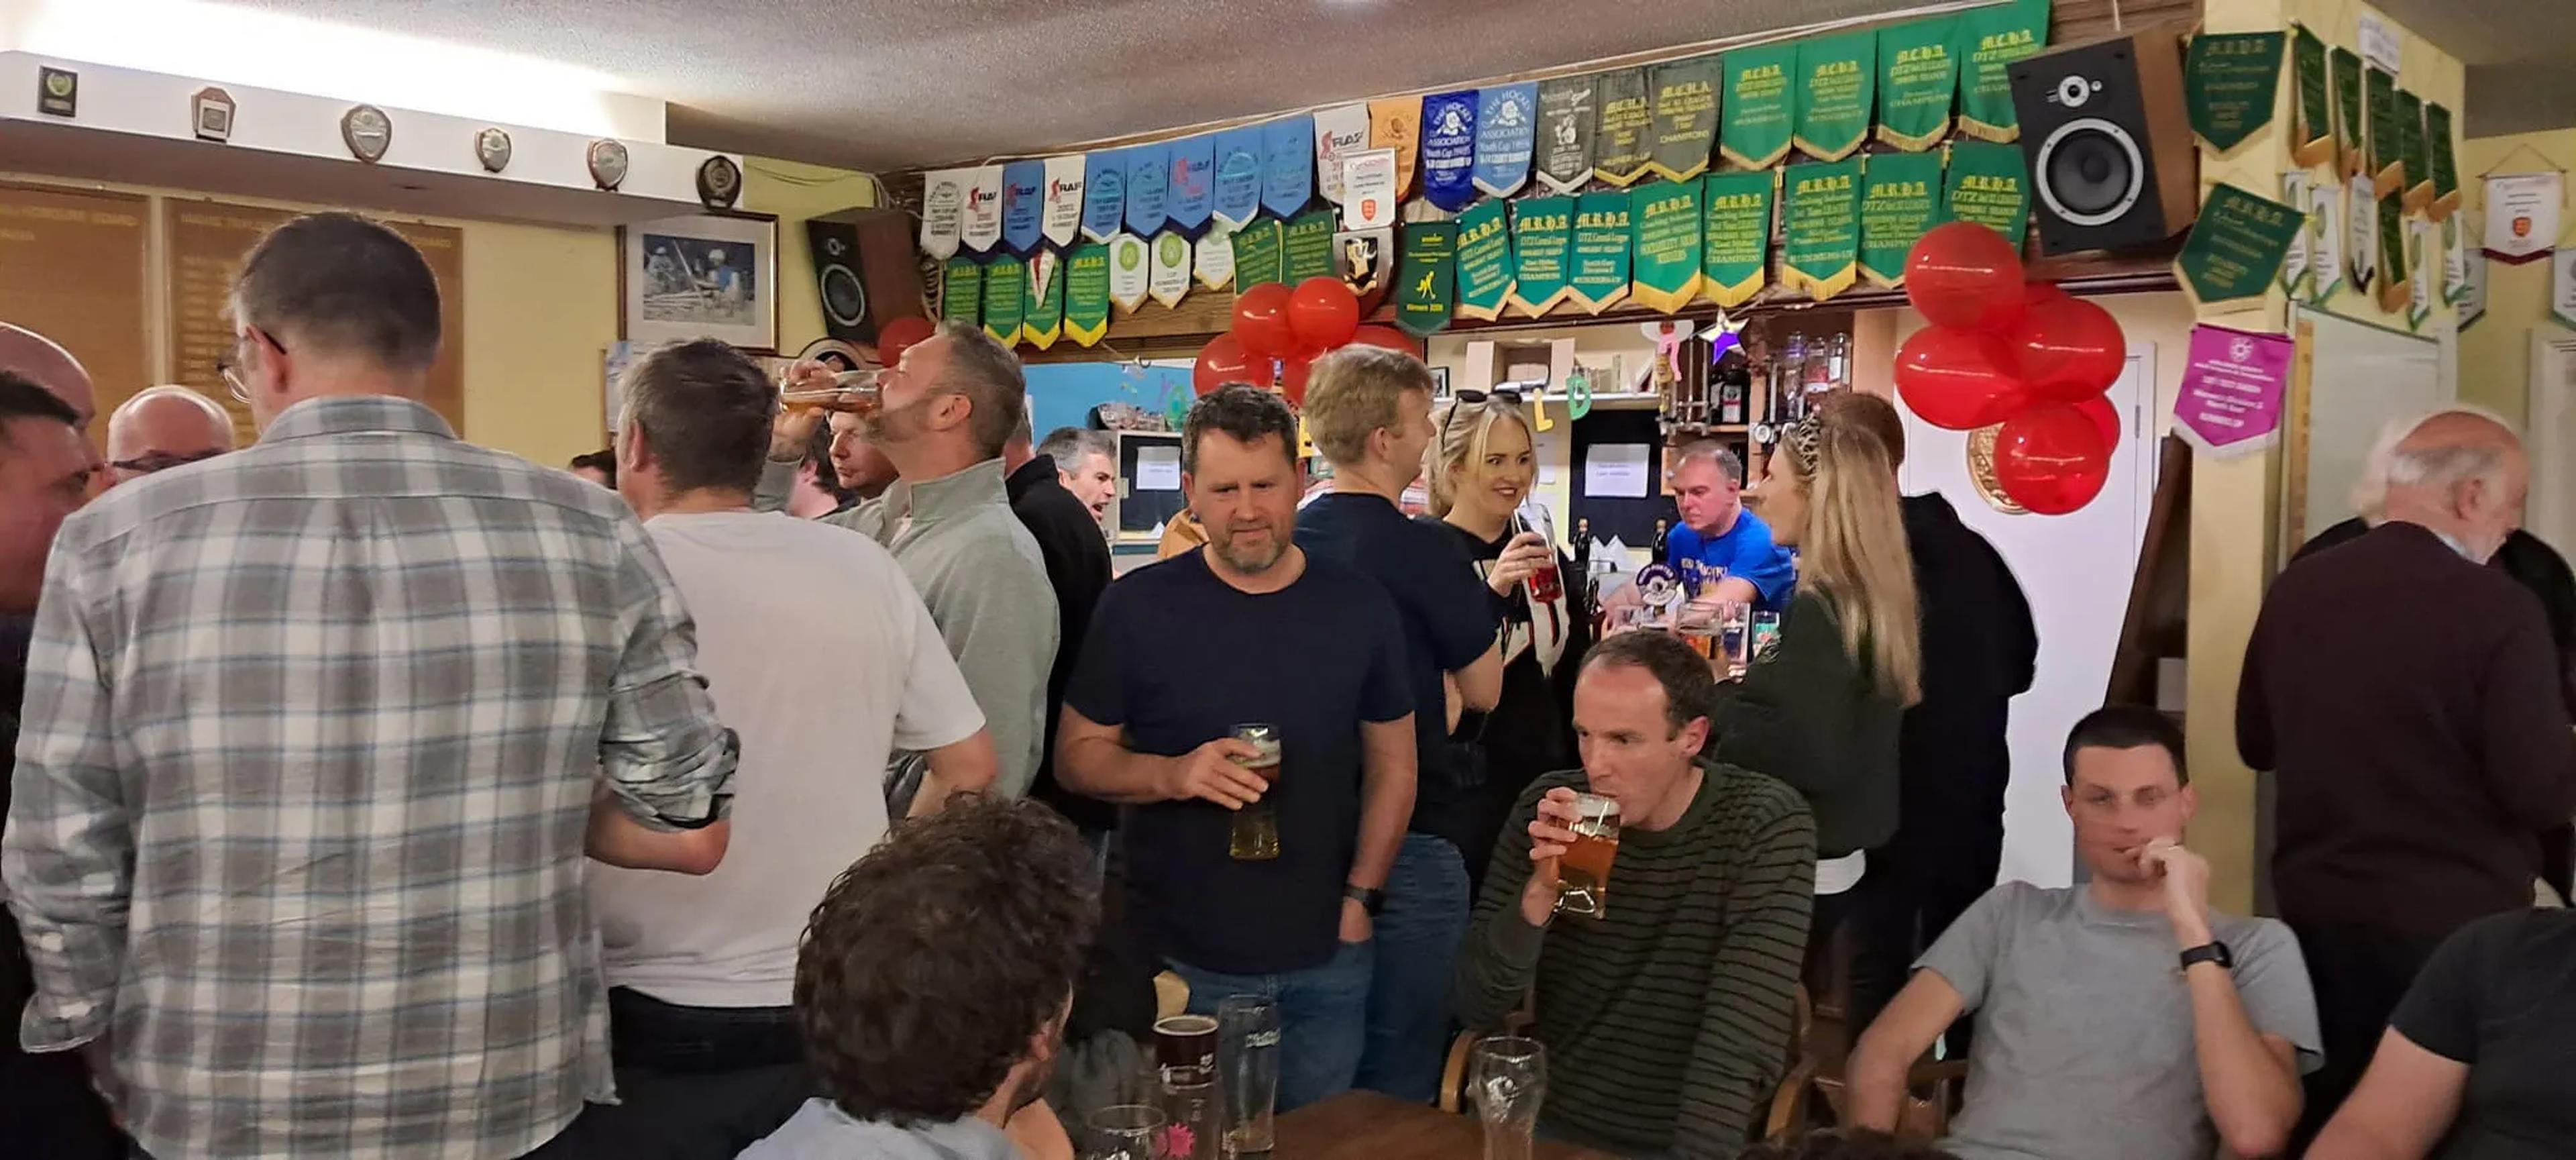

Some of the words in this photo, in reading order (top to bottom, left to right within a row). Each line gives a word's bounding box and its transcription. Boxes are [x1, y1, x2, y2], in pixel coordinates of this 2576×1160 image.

[1501, 89, 1531, 111] HOCKEY
[1446, 101, 1473, 123] HOCKEY
[1442, 147, 1452, 158] Cup
